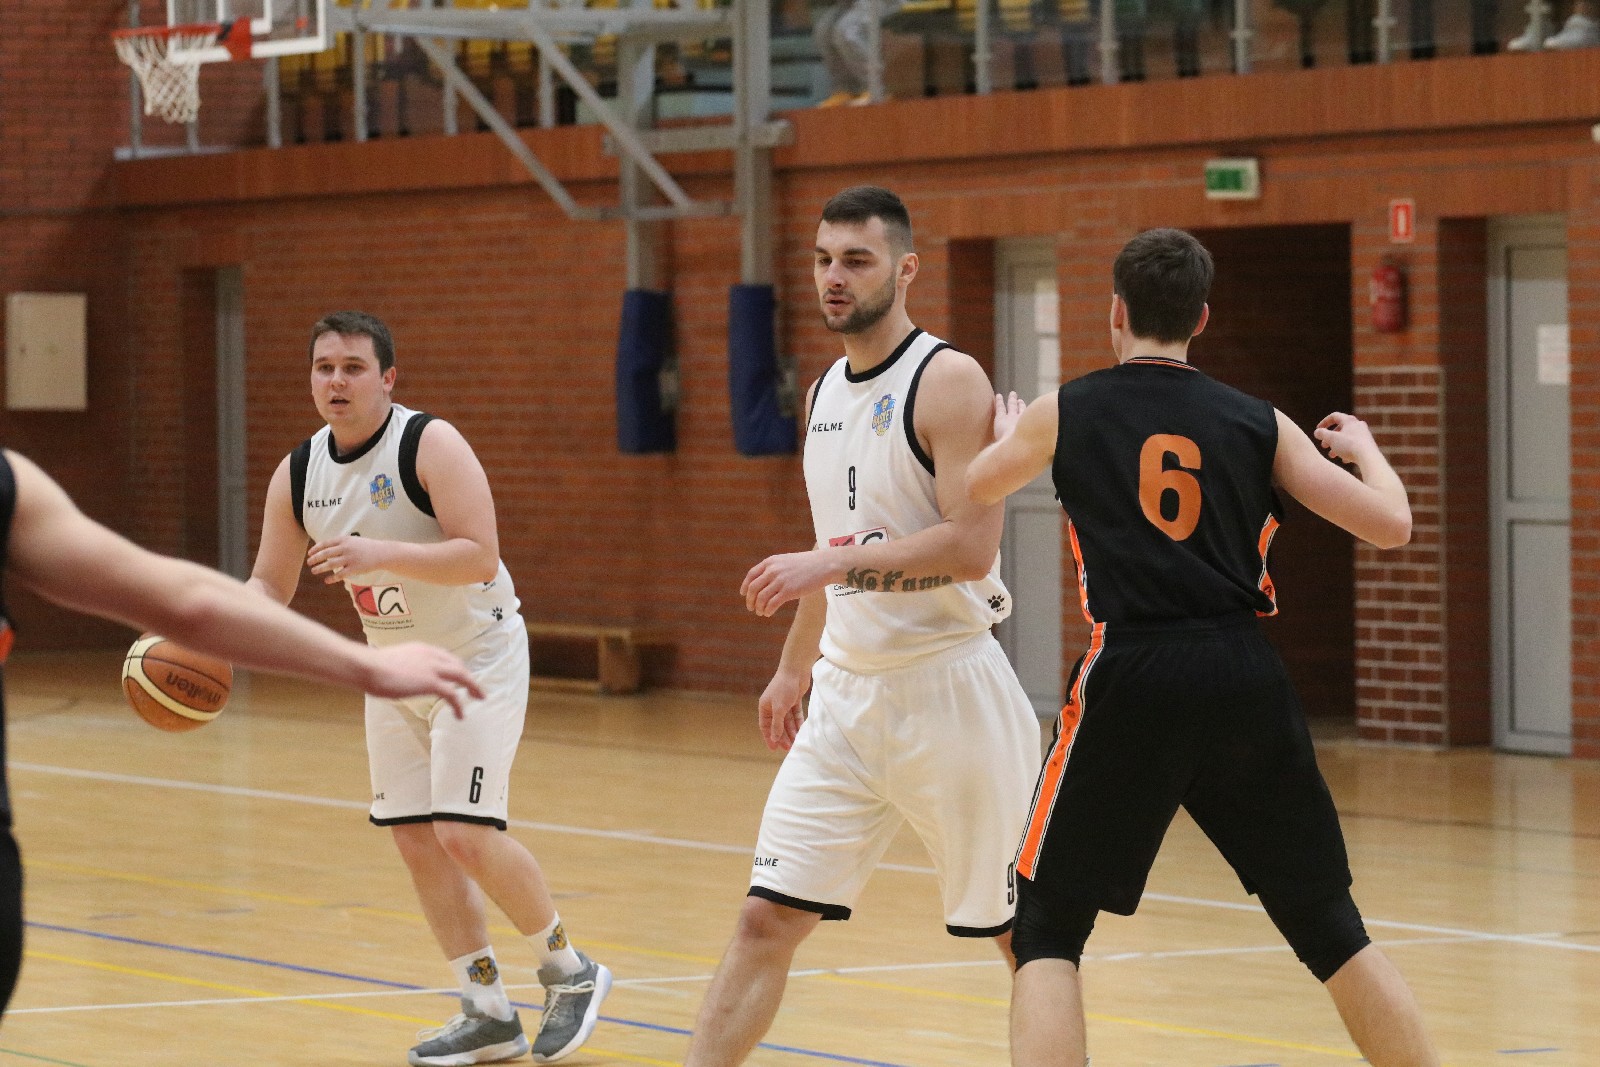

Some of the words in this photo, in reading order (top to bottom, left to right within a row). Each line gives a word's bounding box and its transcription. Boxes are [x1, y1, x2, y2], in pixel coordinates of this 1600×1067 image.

[811, 421, 844, 433] KELME
[307, 497, 342, 508] KELME
[848, 466, 856, 510] 9
[1138, 433, 1202, 542] 6
[166, 672, 221, 703] molten
[469, 766, 484, 804] 6
[1007, 862, 1014, 905] 9
